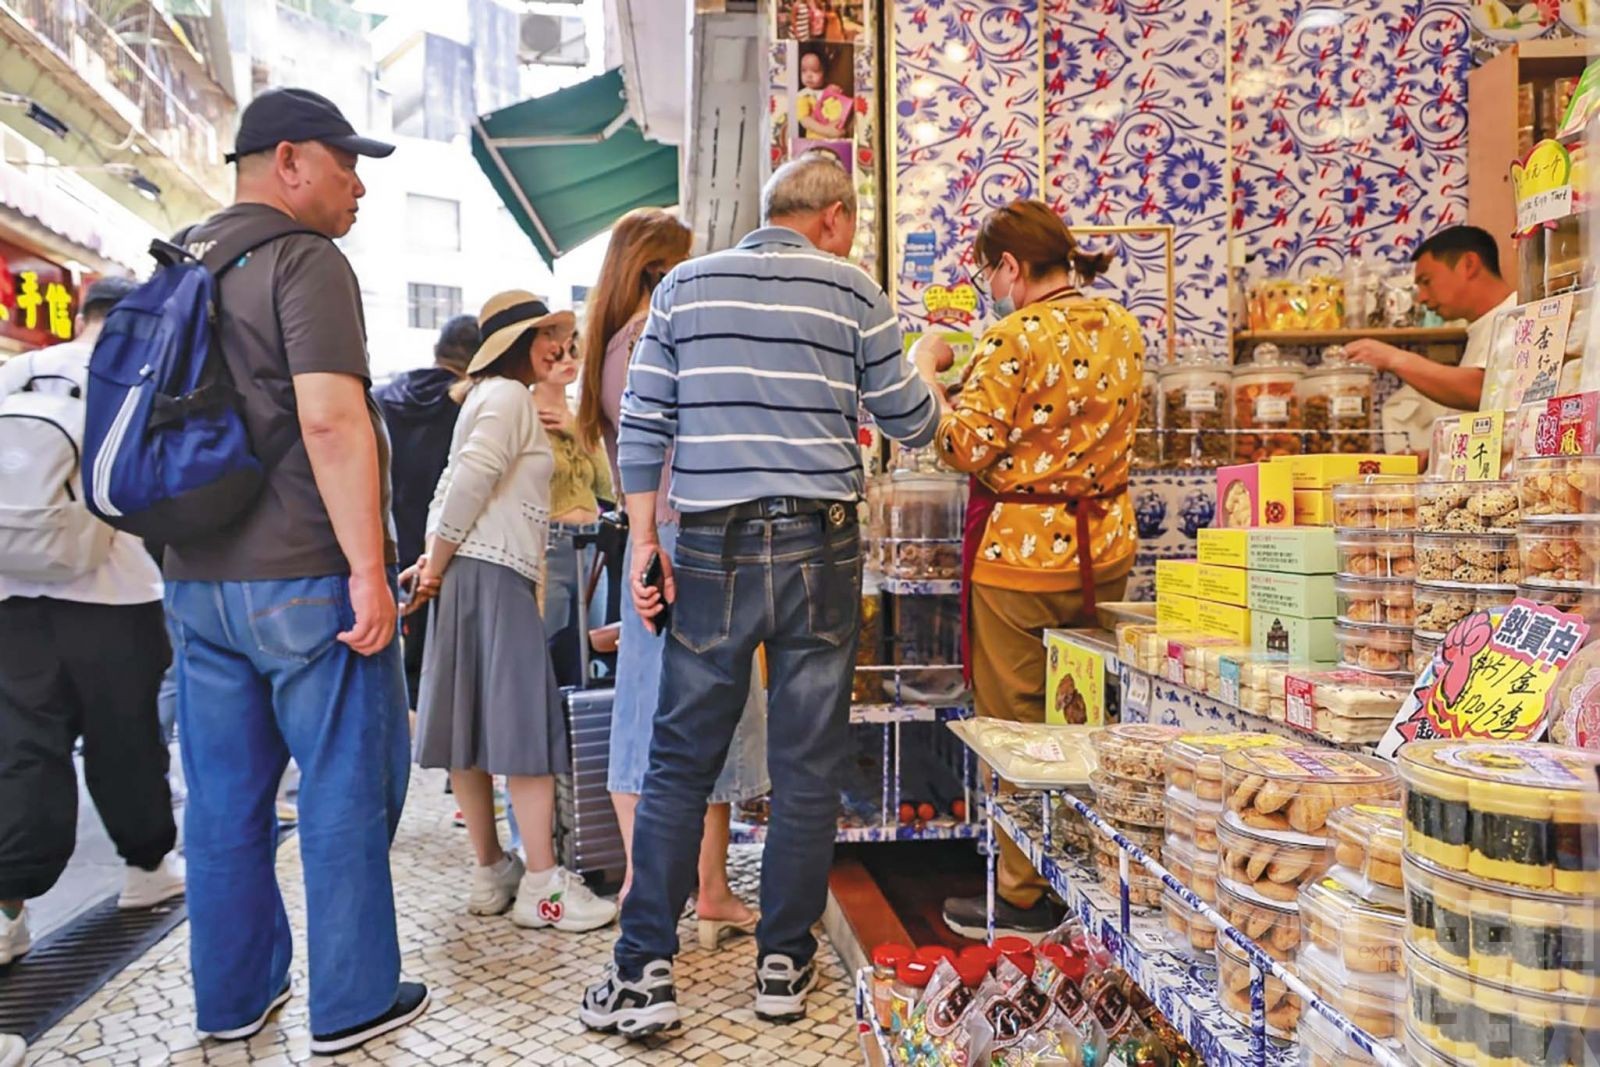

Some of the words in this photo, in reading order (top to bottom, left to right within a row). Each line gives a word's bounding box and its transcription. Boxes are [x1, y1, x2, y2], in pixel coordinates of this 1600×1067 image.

[1551, 189, 1568, 202] Tart
[0, 271, 72, 339] 手信
[1536, 414, 1559, 456] 澳
[1495, 606, 1580, 664] 熱賣中
